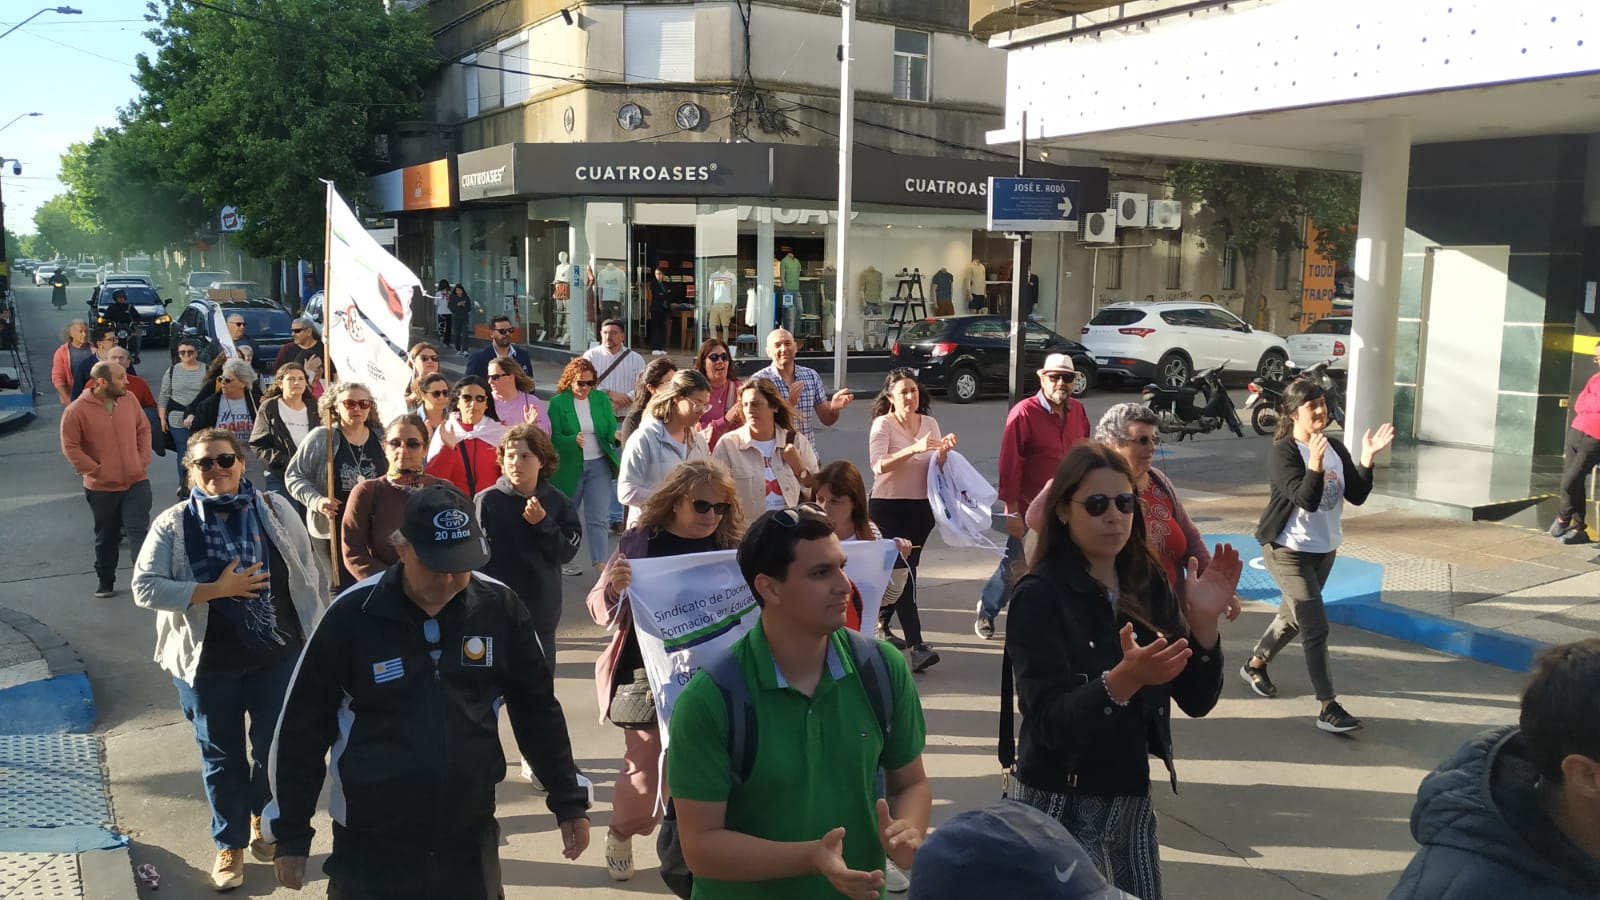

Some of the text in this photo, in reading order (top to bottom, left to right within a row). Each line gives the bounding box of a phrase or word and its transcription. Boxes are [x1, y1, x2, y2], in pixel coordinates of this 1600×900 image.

[1013, 182, 1034, 193] JOSÉ
[1309, 265, 1332, 277] TODO
[435, 529, 470, 541] 20 años
[654, 599, 707, 623] Sindicato
[709, 593, 723, 606] de
[660, 613, 716, 637] Formación
[717, 608, 727, 618] en
